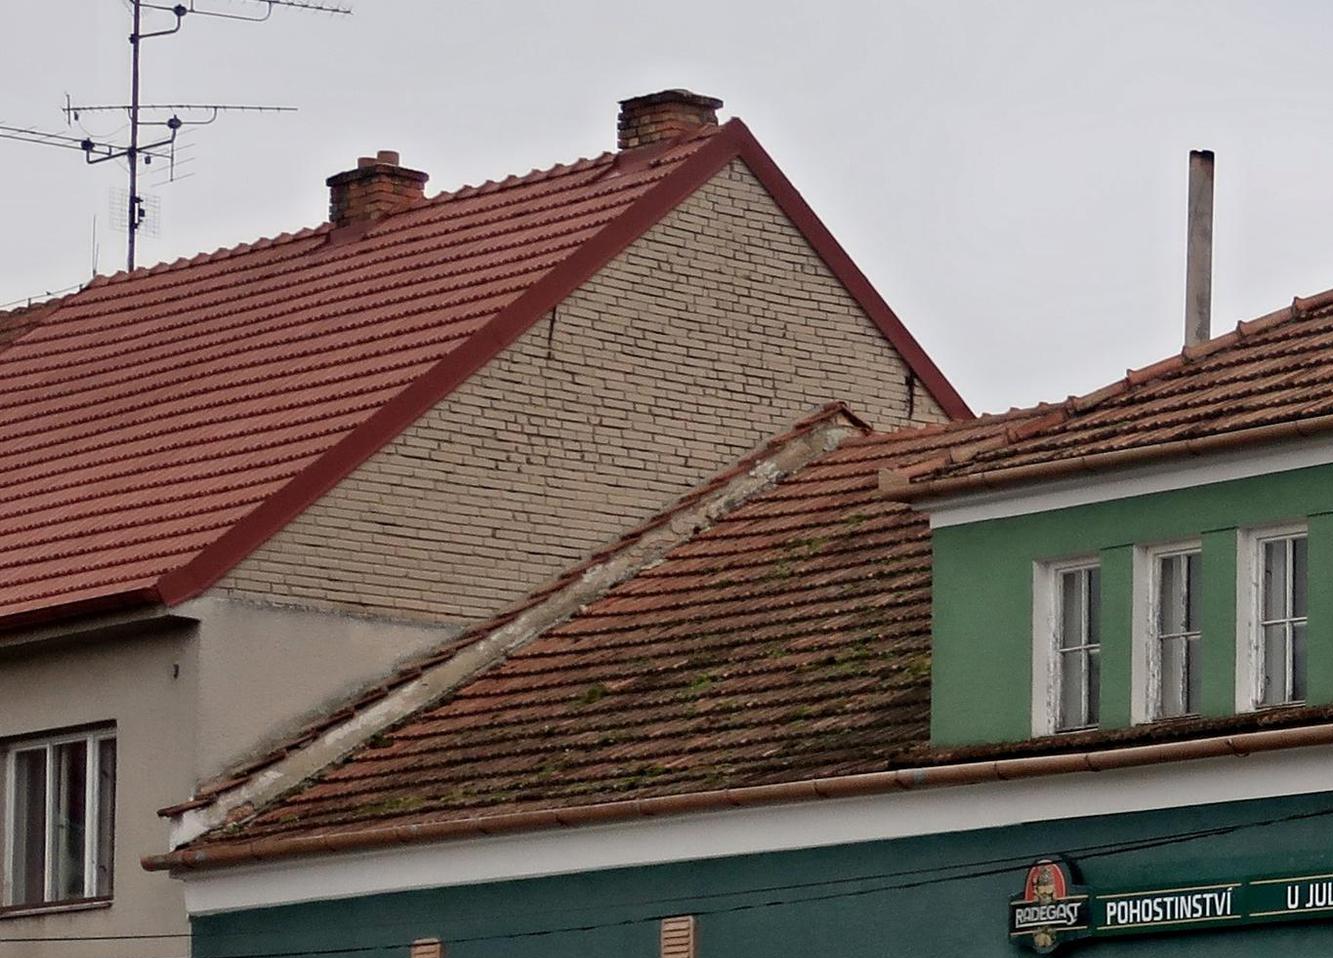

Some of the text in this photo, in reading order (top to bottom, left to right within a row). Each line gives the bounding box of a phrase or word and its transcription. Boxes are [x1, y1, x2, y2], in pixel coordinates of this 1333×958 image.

[1015, 902, 1082, 928] RADEGAST
[1106, 887, 1233, 925] POHOSTINSTVÍ
[1287, 885, 1299, 909] U
